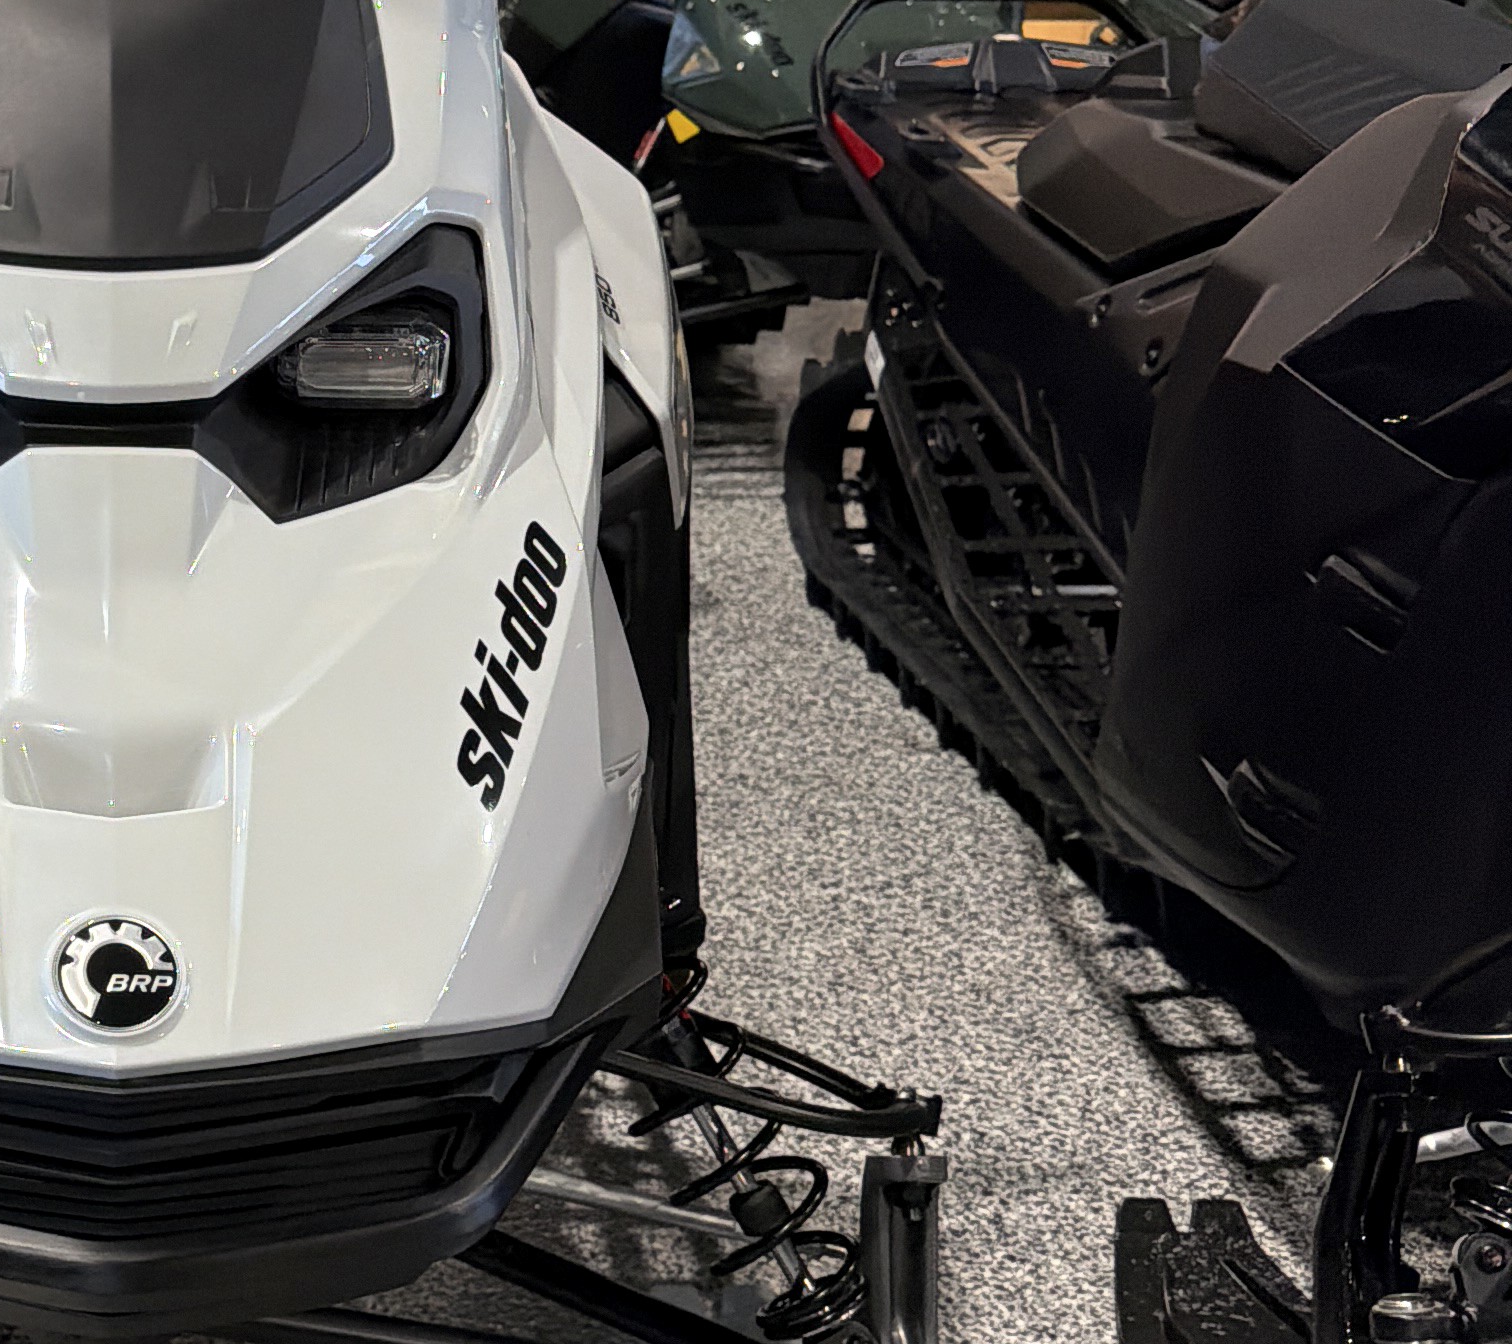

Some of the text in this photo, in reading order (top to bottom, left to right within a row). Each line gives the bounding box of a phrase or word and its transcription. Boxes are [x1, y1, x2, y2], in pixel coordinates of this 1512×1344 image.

[595, 273, 621, 325] 850
[457, 520, 567, 812] ski-doo
[105, 972, 174, 994] BRP
